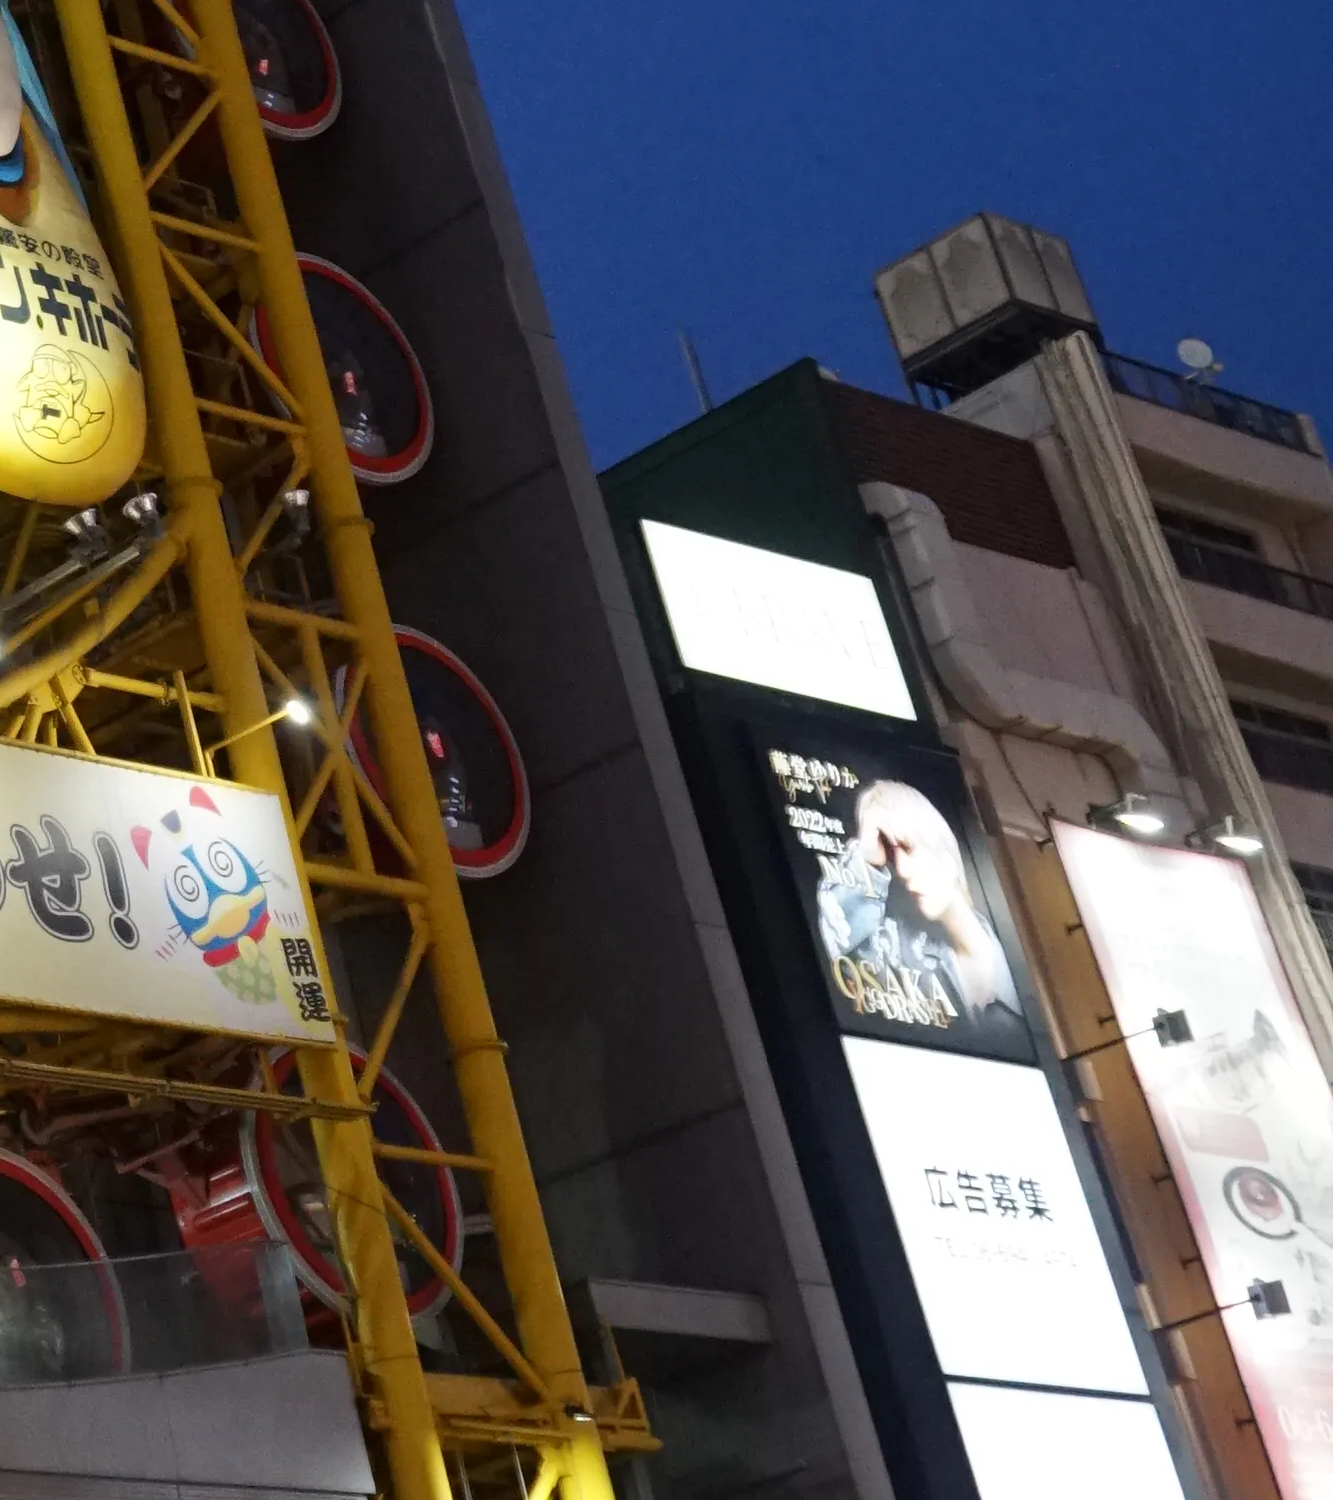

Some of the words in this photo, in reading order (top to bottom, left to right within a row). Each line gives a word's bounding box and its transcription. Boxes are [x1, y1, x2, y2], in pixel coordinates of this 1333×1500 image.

[280, 936, 331, 1025] 開運
[832, 955, 960, 1018] OSAKA
[923, 1165, 1054, 1223] 広告募集
